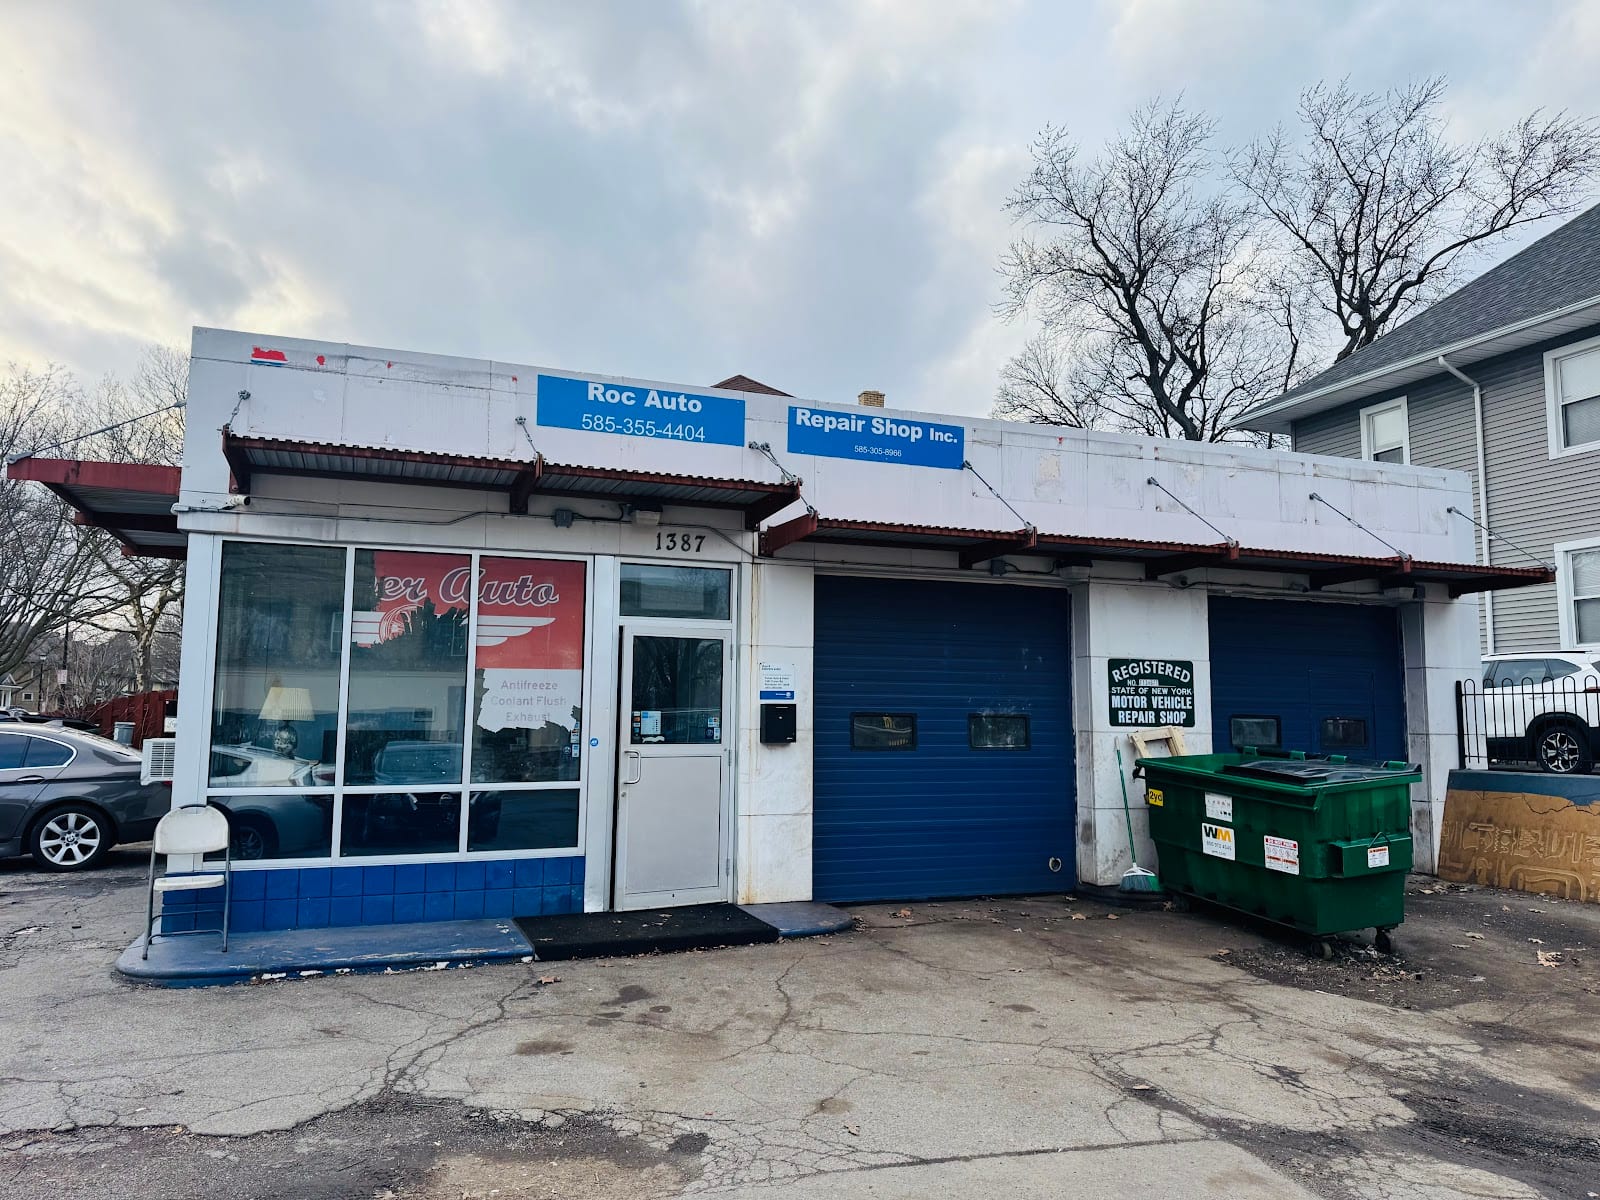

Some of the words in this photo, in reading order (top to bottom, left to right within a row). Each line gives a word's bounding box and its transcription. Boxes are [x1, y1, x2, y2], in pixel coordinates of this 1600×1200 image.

[587, 382, 636, 405] Roc
[644, 389, 702, 413] Auto
[581, 413, 705, 441] 585-355-4404
[796, 408, 866, 432] Repair
[871, 418, 922, 442] Shop
[930, 428, 958, 443] Inc.
[656, 532, 706, 552] 1387
[439, 566, 560, 607] Auto
[1112, 661, 1191, 683] REGISTERED
[501, 680, 558, 690] Antifreeze
[491, 696, 533, 706] Coolant
[537, 696, 567, 706] Flush
[1111, 695, 1148, 708] MOTOR
[1152, 696, 1192, 709] VEHICLE
[506, 712, 551, 722] Exhaust
[1118, 710, 1155, 724] REPAIR
[1160, 710, 1187, 724] SHOP
[1204, 825, 1232, 842] WM
